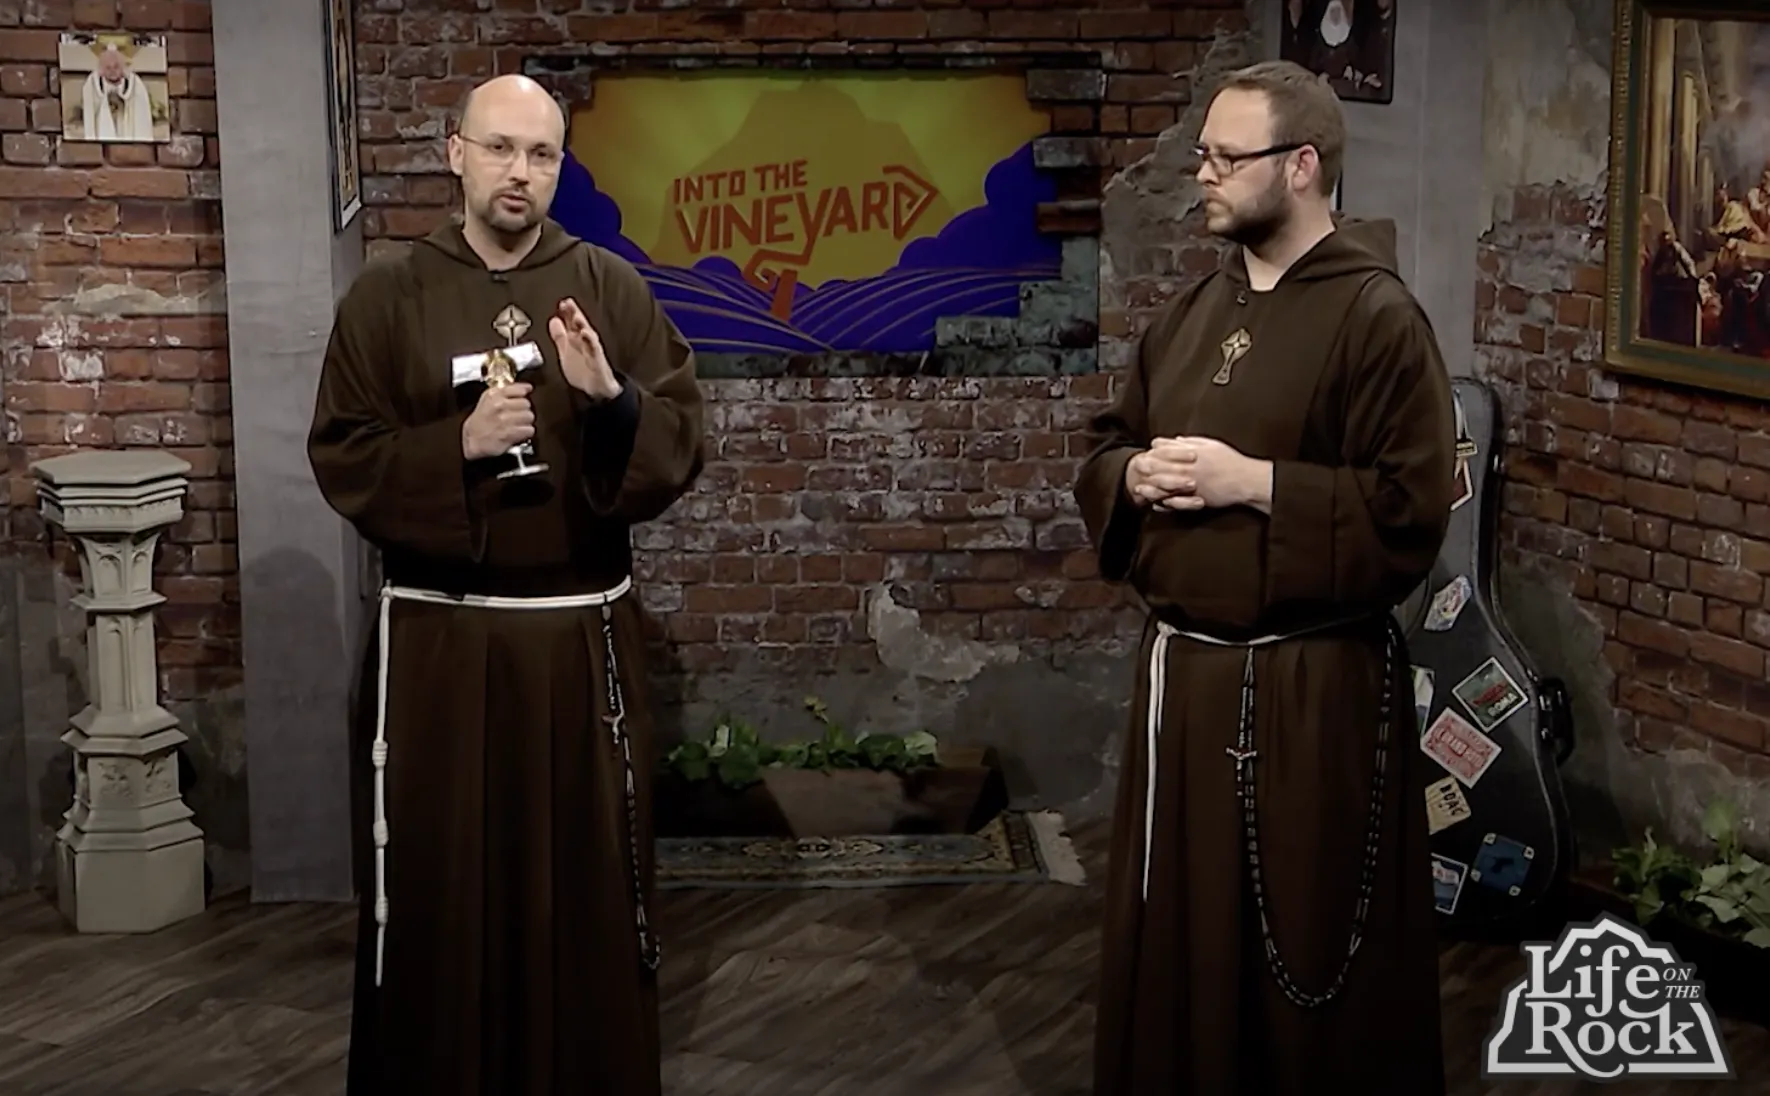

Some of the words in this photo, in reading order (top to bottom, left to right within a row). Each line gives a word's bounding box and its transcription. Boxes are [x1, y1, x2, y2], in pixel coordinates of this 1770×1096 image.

[674, 170, 746, 205] INTO
[753, 159, 808, 192] THE
[675, 165, 939, 292] VINEYARD
